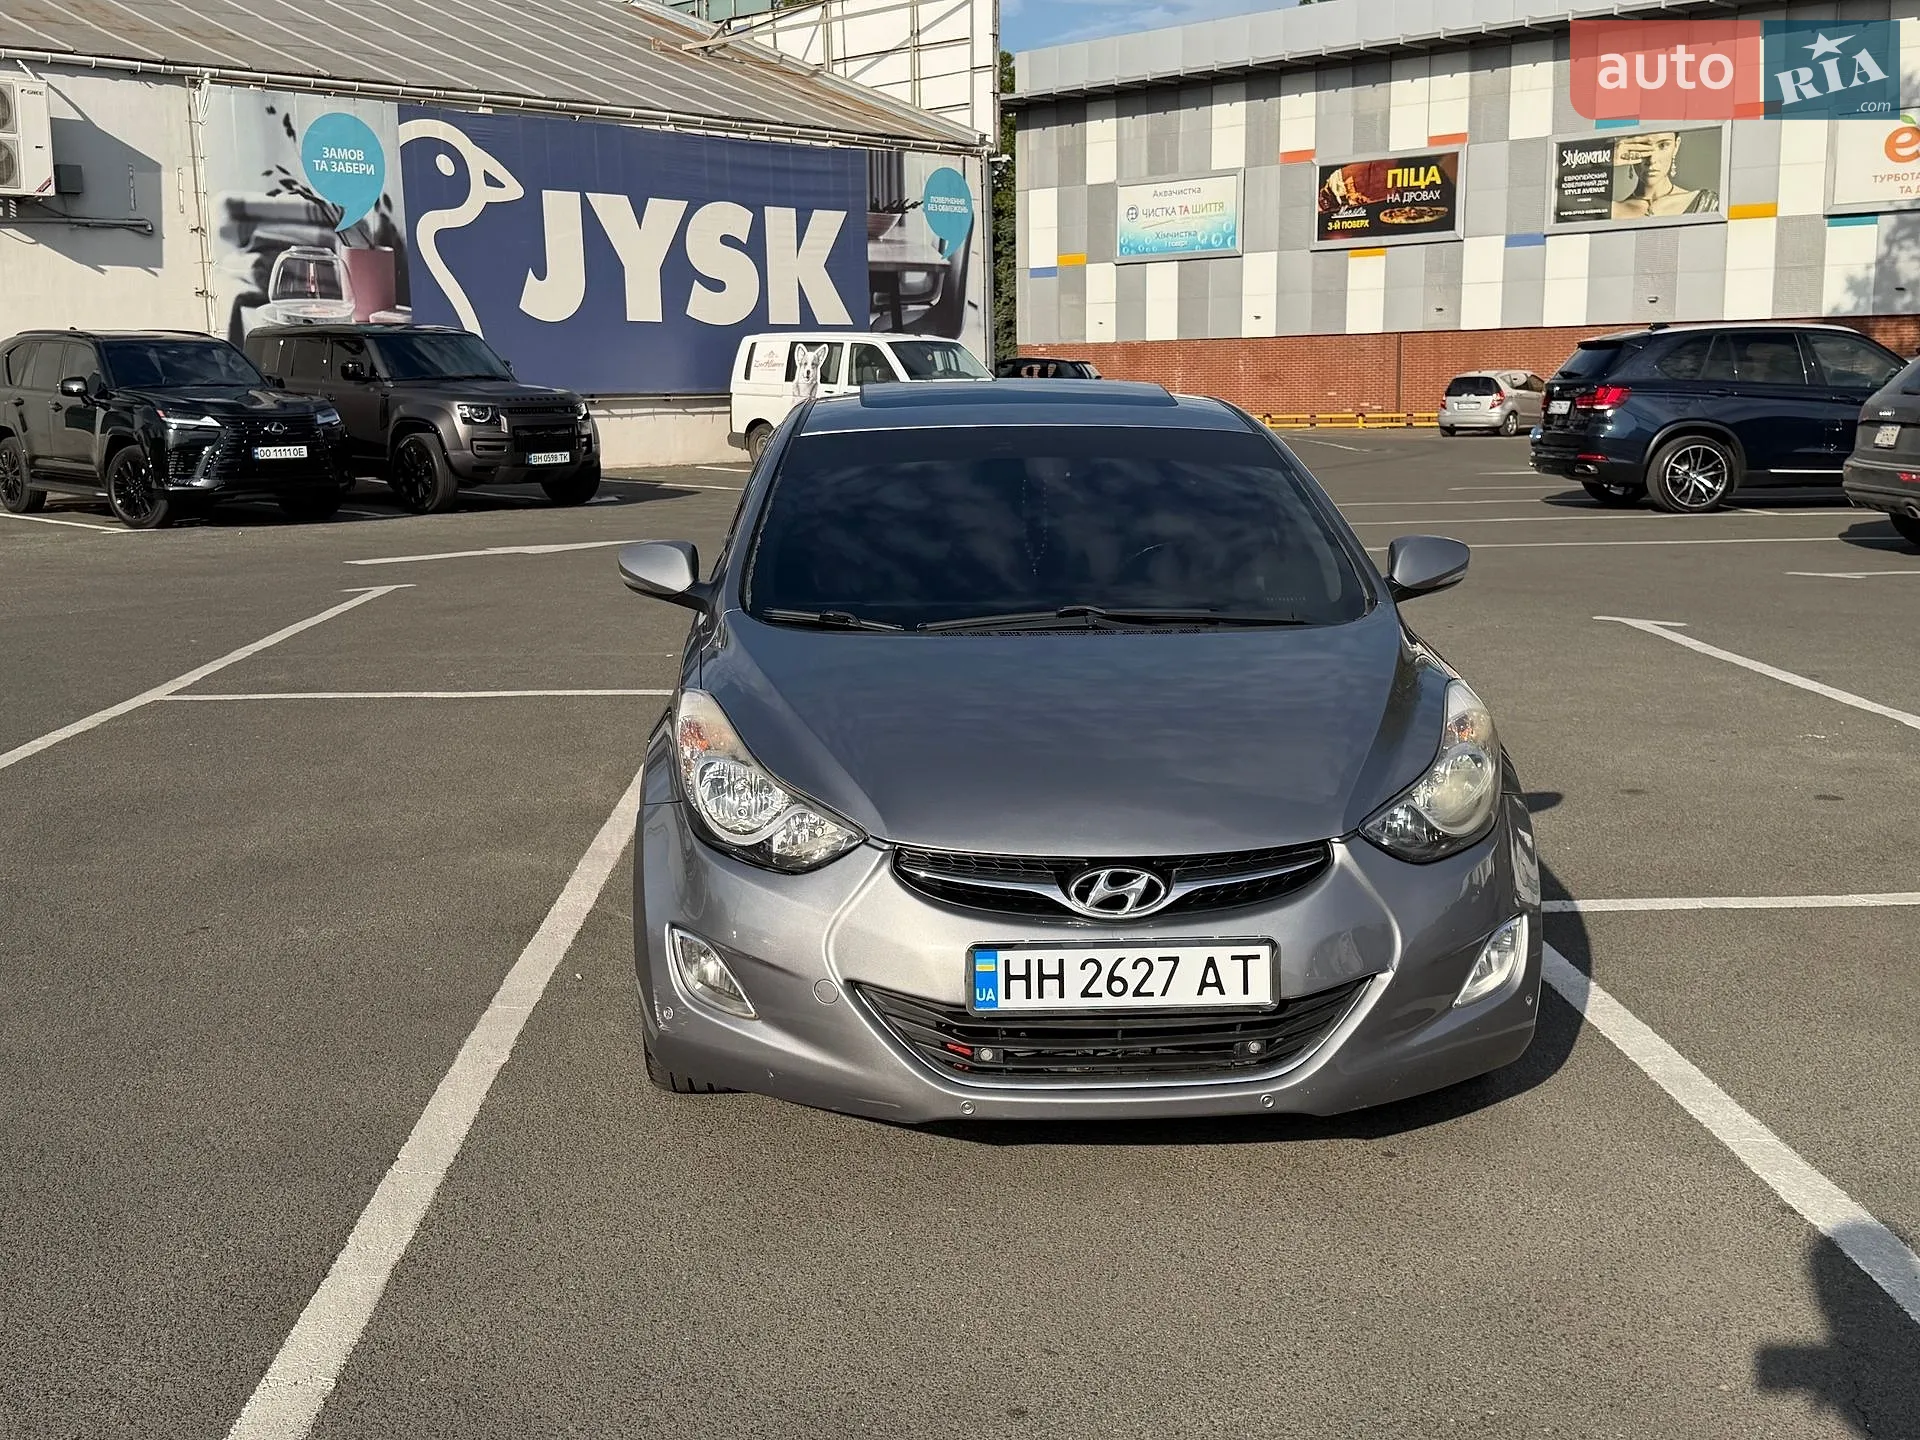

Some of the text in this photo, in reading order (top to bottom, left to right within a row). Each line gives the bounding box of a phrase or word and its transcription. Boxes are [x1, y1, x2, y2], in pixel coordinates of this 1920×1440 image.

[322, 147, 364, 160] ЗАМОВ
[313, 160, 375, 175] ТА ЗАБЕРИ
[1387, 166, 1442, 189] ПІЦА
[1153, 187, 1202, 198] Аквачистка
[1387, 190, 1440, 203] НА ДРОВАХ
[1900, 186, 1912, 194] ТА
[1142, 202, 1224, 218] ЧИСТКА ТА ШИТТЯ
[1342, 220, 1369, 229] ПОВЕРХ
[1155, 230, 1198, 240] Хімчистка
[519, 190, 854, 326] JYSK
[1004, 954, 1261, 1000] HH 2627 AT
[976, 988, 996, 1002] UA
